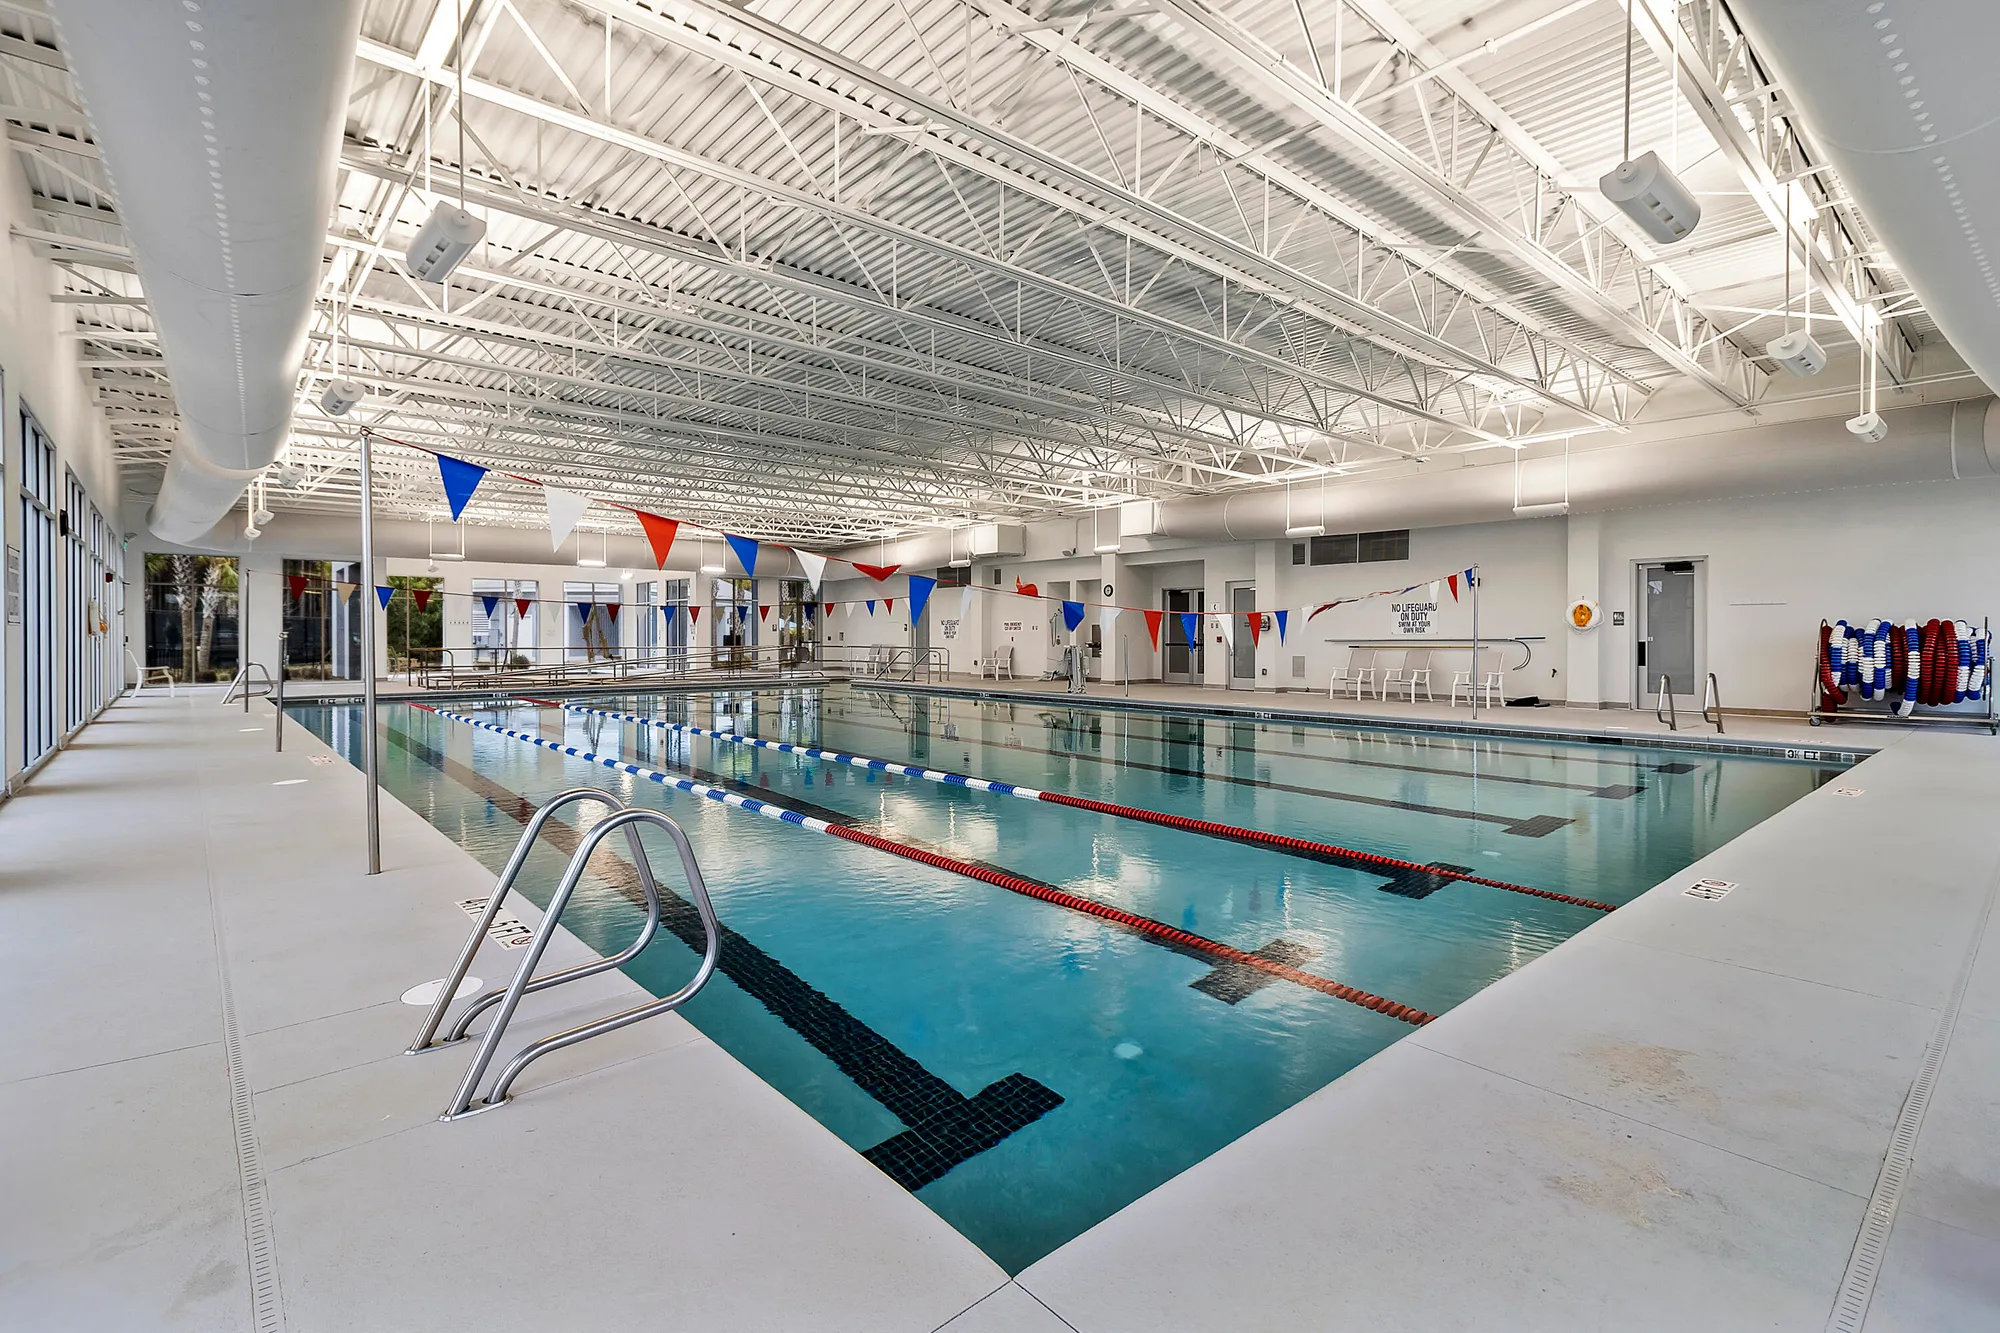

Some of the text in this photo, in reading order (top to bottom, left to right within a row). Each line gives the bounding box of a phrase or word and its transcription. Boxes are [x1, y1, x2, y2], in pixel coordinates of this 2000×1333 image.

[1391, 602, 1438, 612] NO LIFEGUARD
[1401, 612, 1428, 621] ON DUTY
